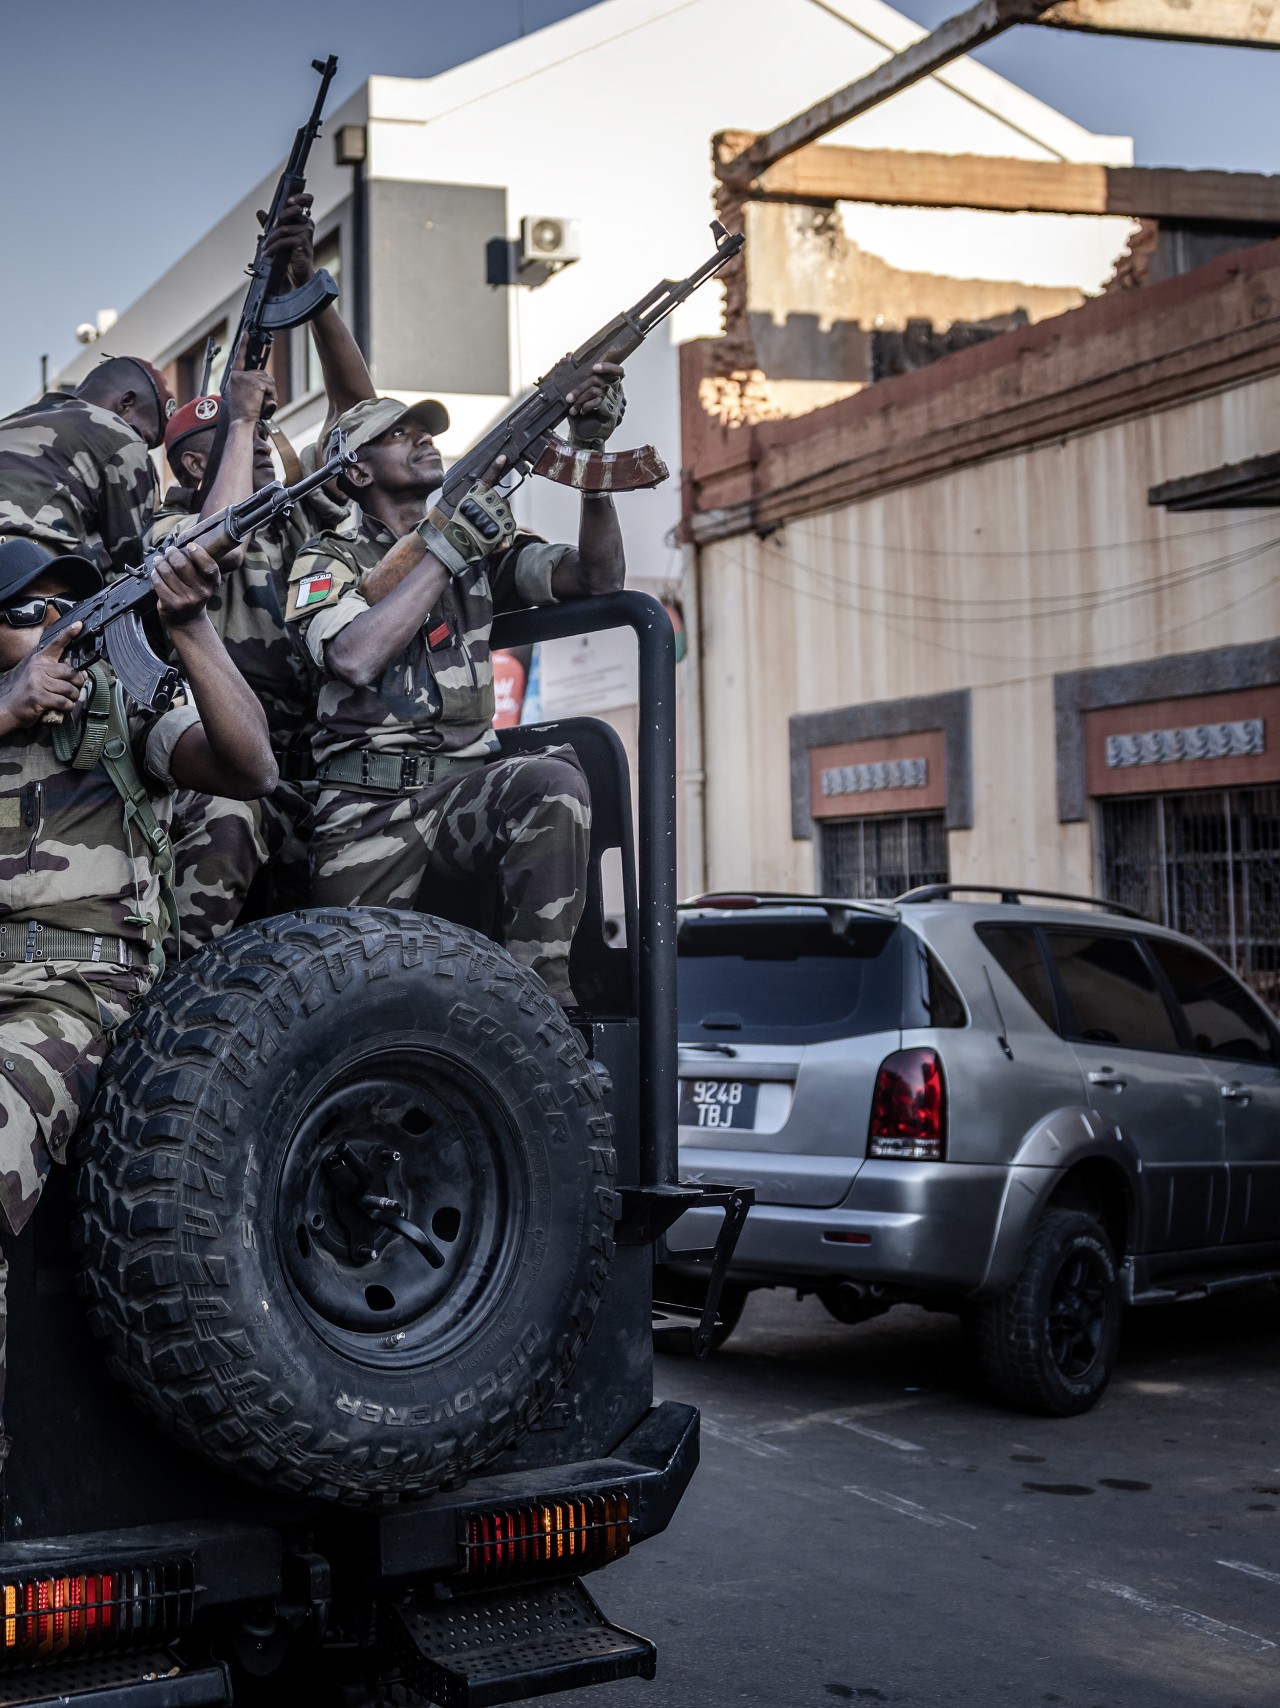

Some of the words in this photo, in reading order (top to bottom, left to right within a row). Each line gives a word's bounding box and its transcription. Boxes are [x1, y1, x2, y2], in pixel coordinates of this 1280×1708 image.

[448, 1001, 572, 1143] COOPER
[693, 1081, 743, 1104] 9248
[697, 1104, 734, 1128] TBJ
[334, 1320, 544, 1427] DISCOVERER
